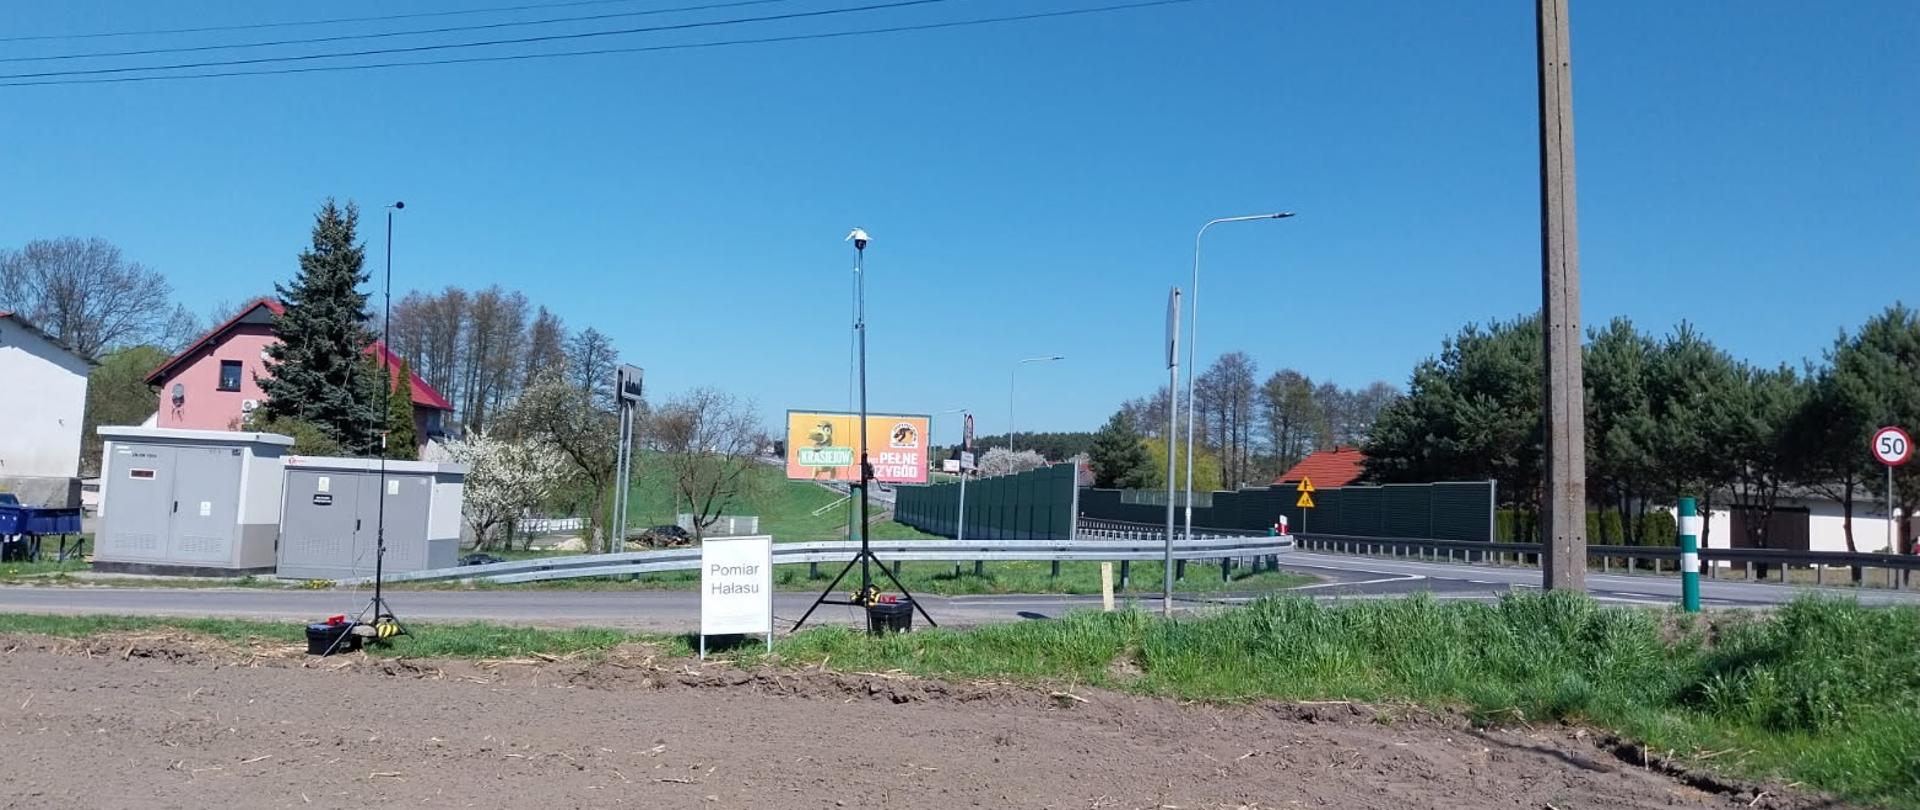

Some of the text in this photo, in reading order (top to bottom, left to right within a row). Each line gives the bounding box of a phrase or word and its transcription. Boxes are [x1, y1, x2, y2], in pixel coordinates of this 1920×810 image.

[1881, 437, 1905, 455] 50
[711, 563, 760, 576] Pomiar
[712, 582, 759, 595] Hałasu
